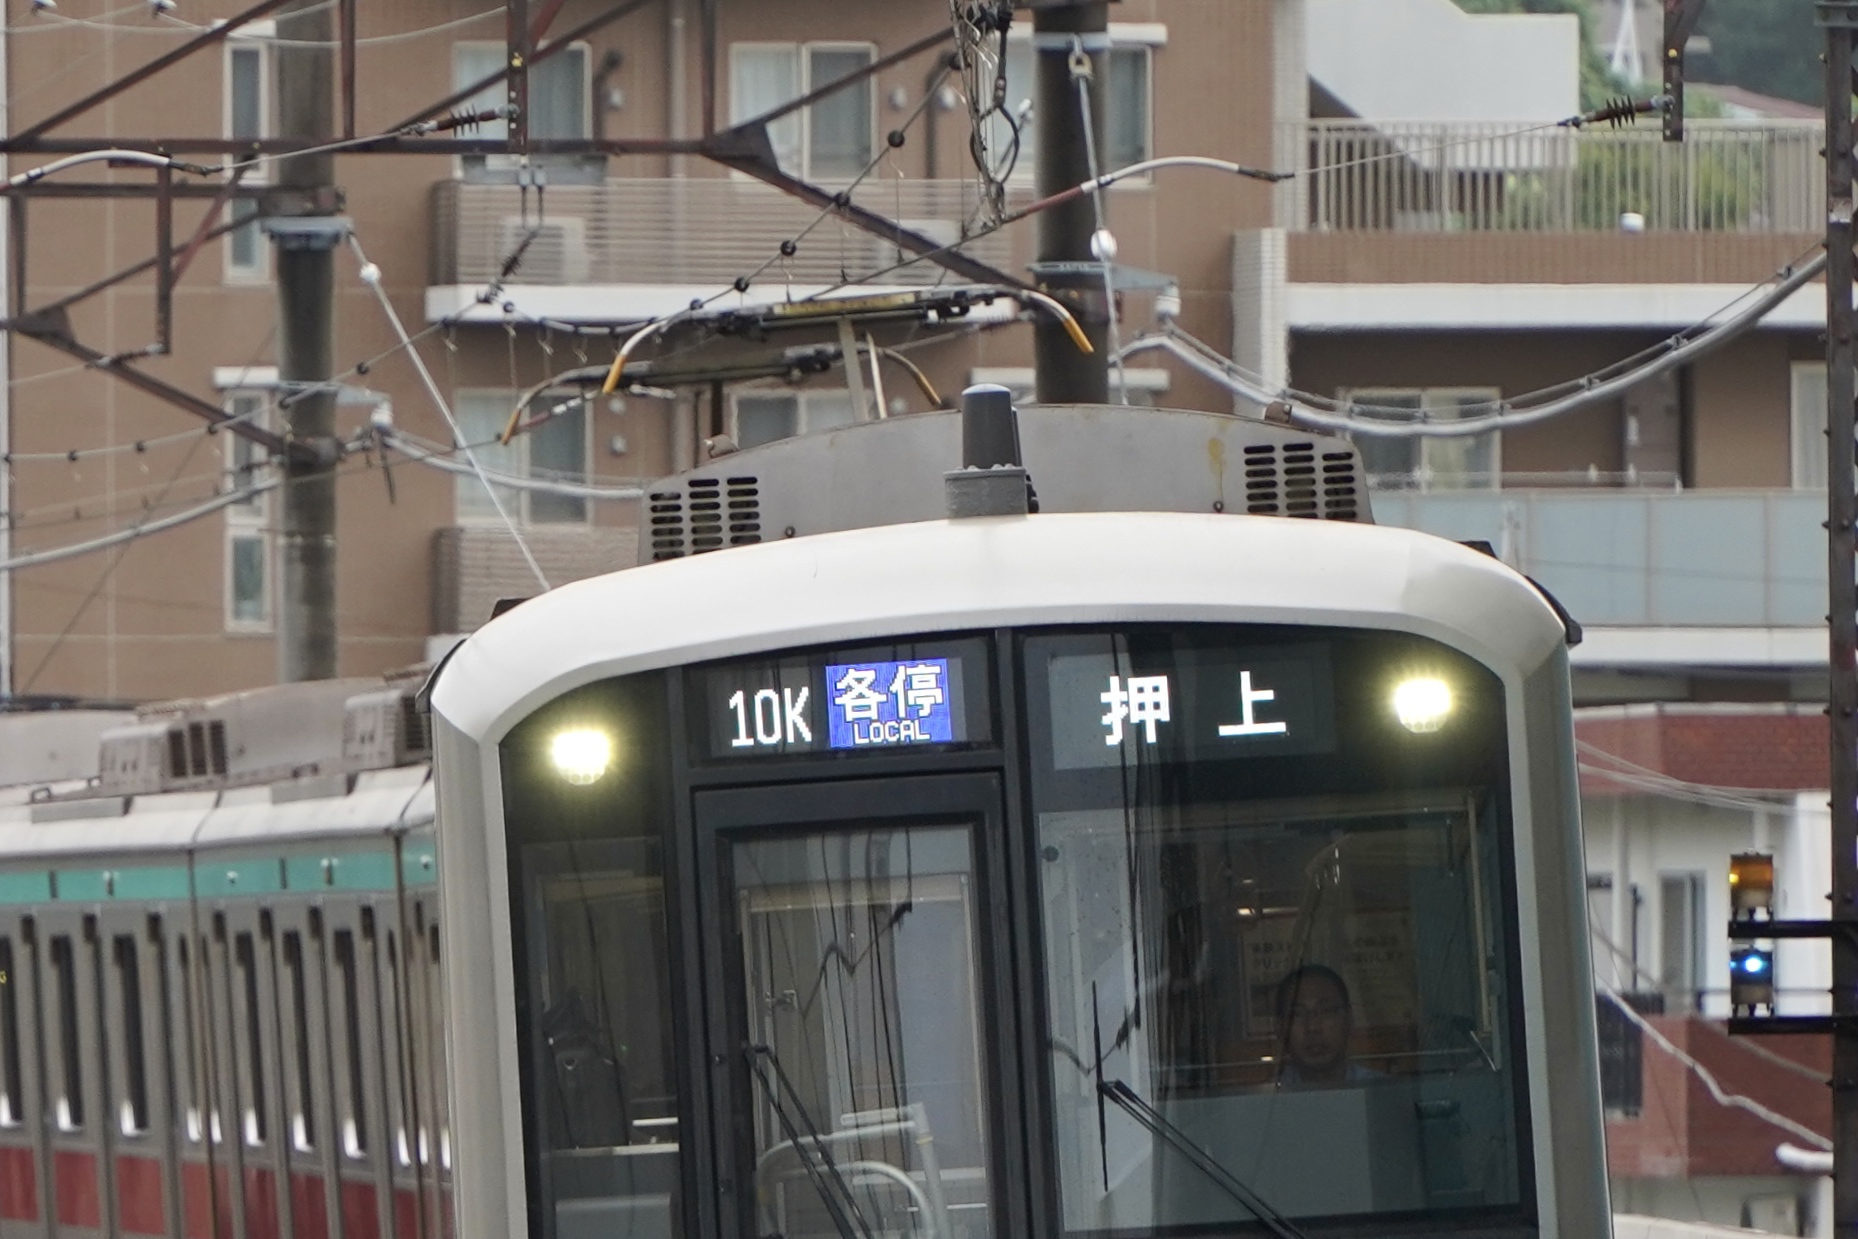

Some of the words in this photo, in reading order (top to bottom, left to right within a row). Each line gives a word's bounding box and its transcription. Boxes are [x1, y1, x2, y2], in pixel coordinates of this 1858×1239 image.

[729, 686, 813, 747] 10K
[834, 664, 944, 722] 各停
[1101, 671, 1287, 747] 押上
[853, 719, 931, 746] LOCAL
